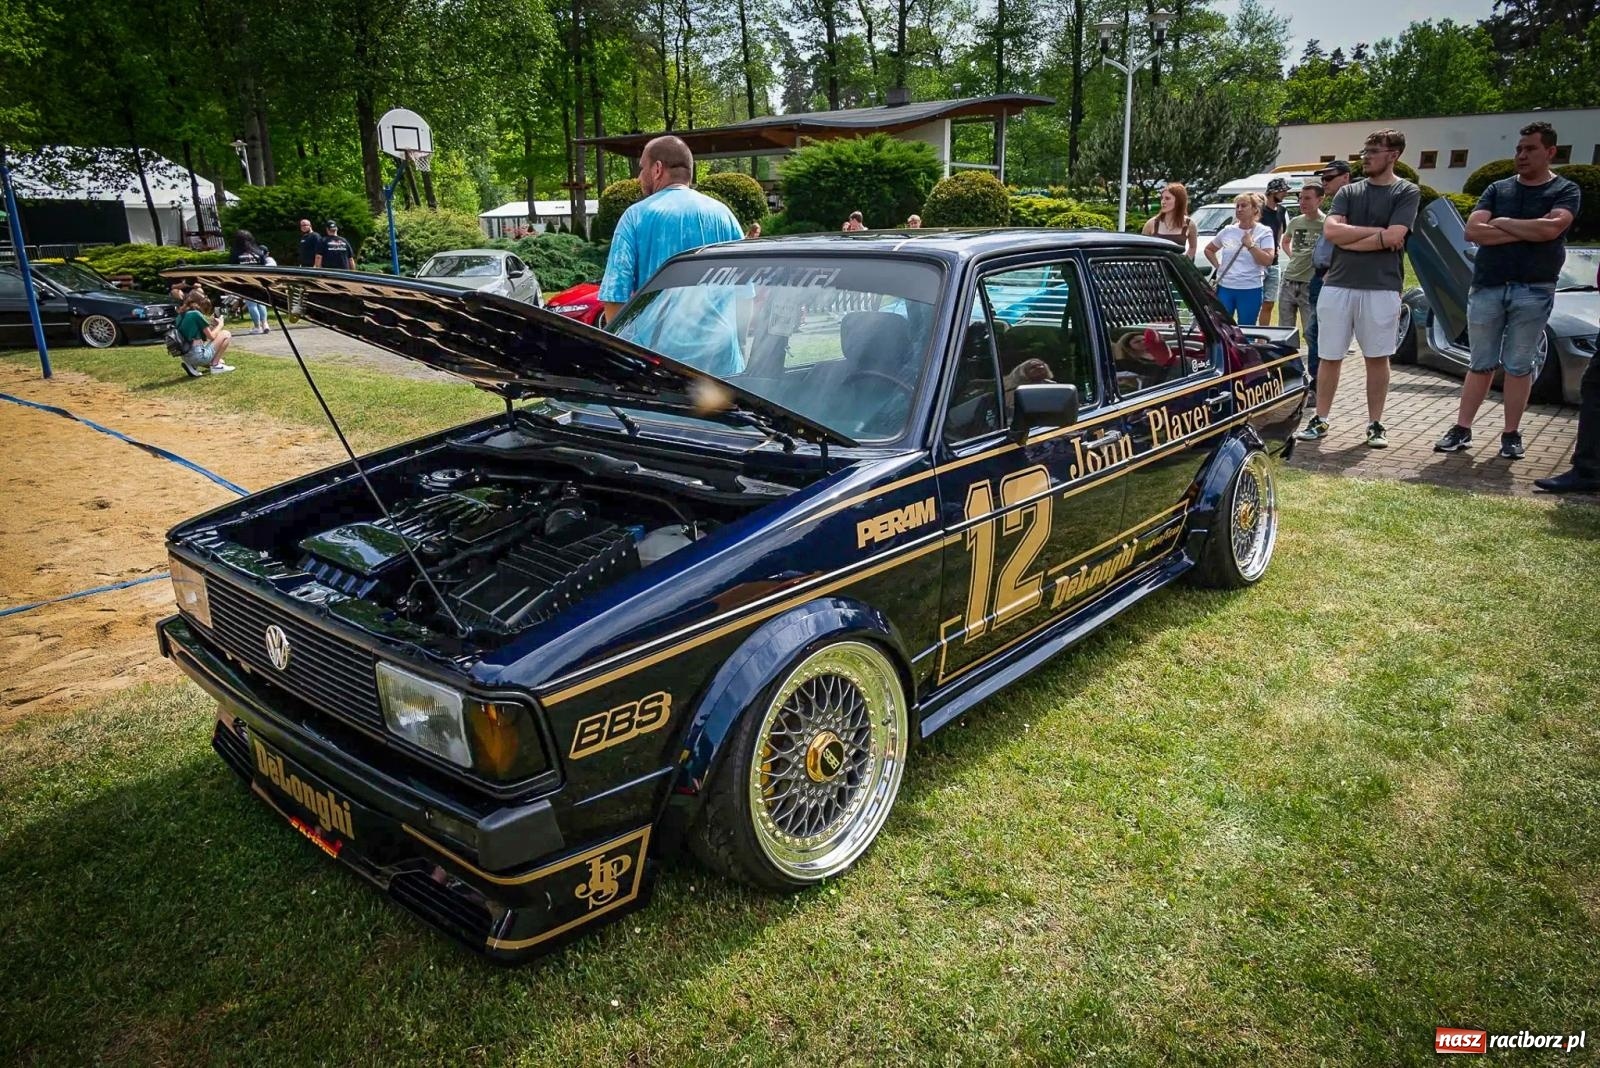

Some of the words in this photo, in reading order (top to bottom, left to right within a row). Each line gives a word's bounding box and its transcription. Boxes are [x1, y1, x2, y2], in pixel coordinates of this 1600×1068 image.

[696, 266, 748, 287] LOW
[1070, 428, 1134, 480] John
[1234, 368, 1285, 413] Special
[964, 464, 1053, 645] 12
[569, 691, 671, 760] BBS
